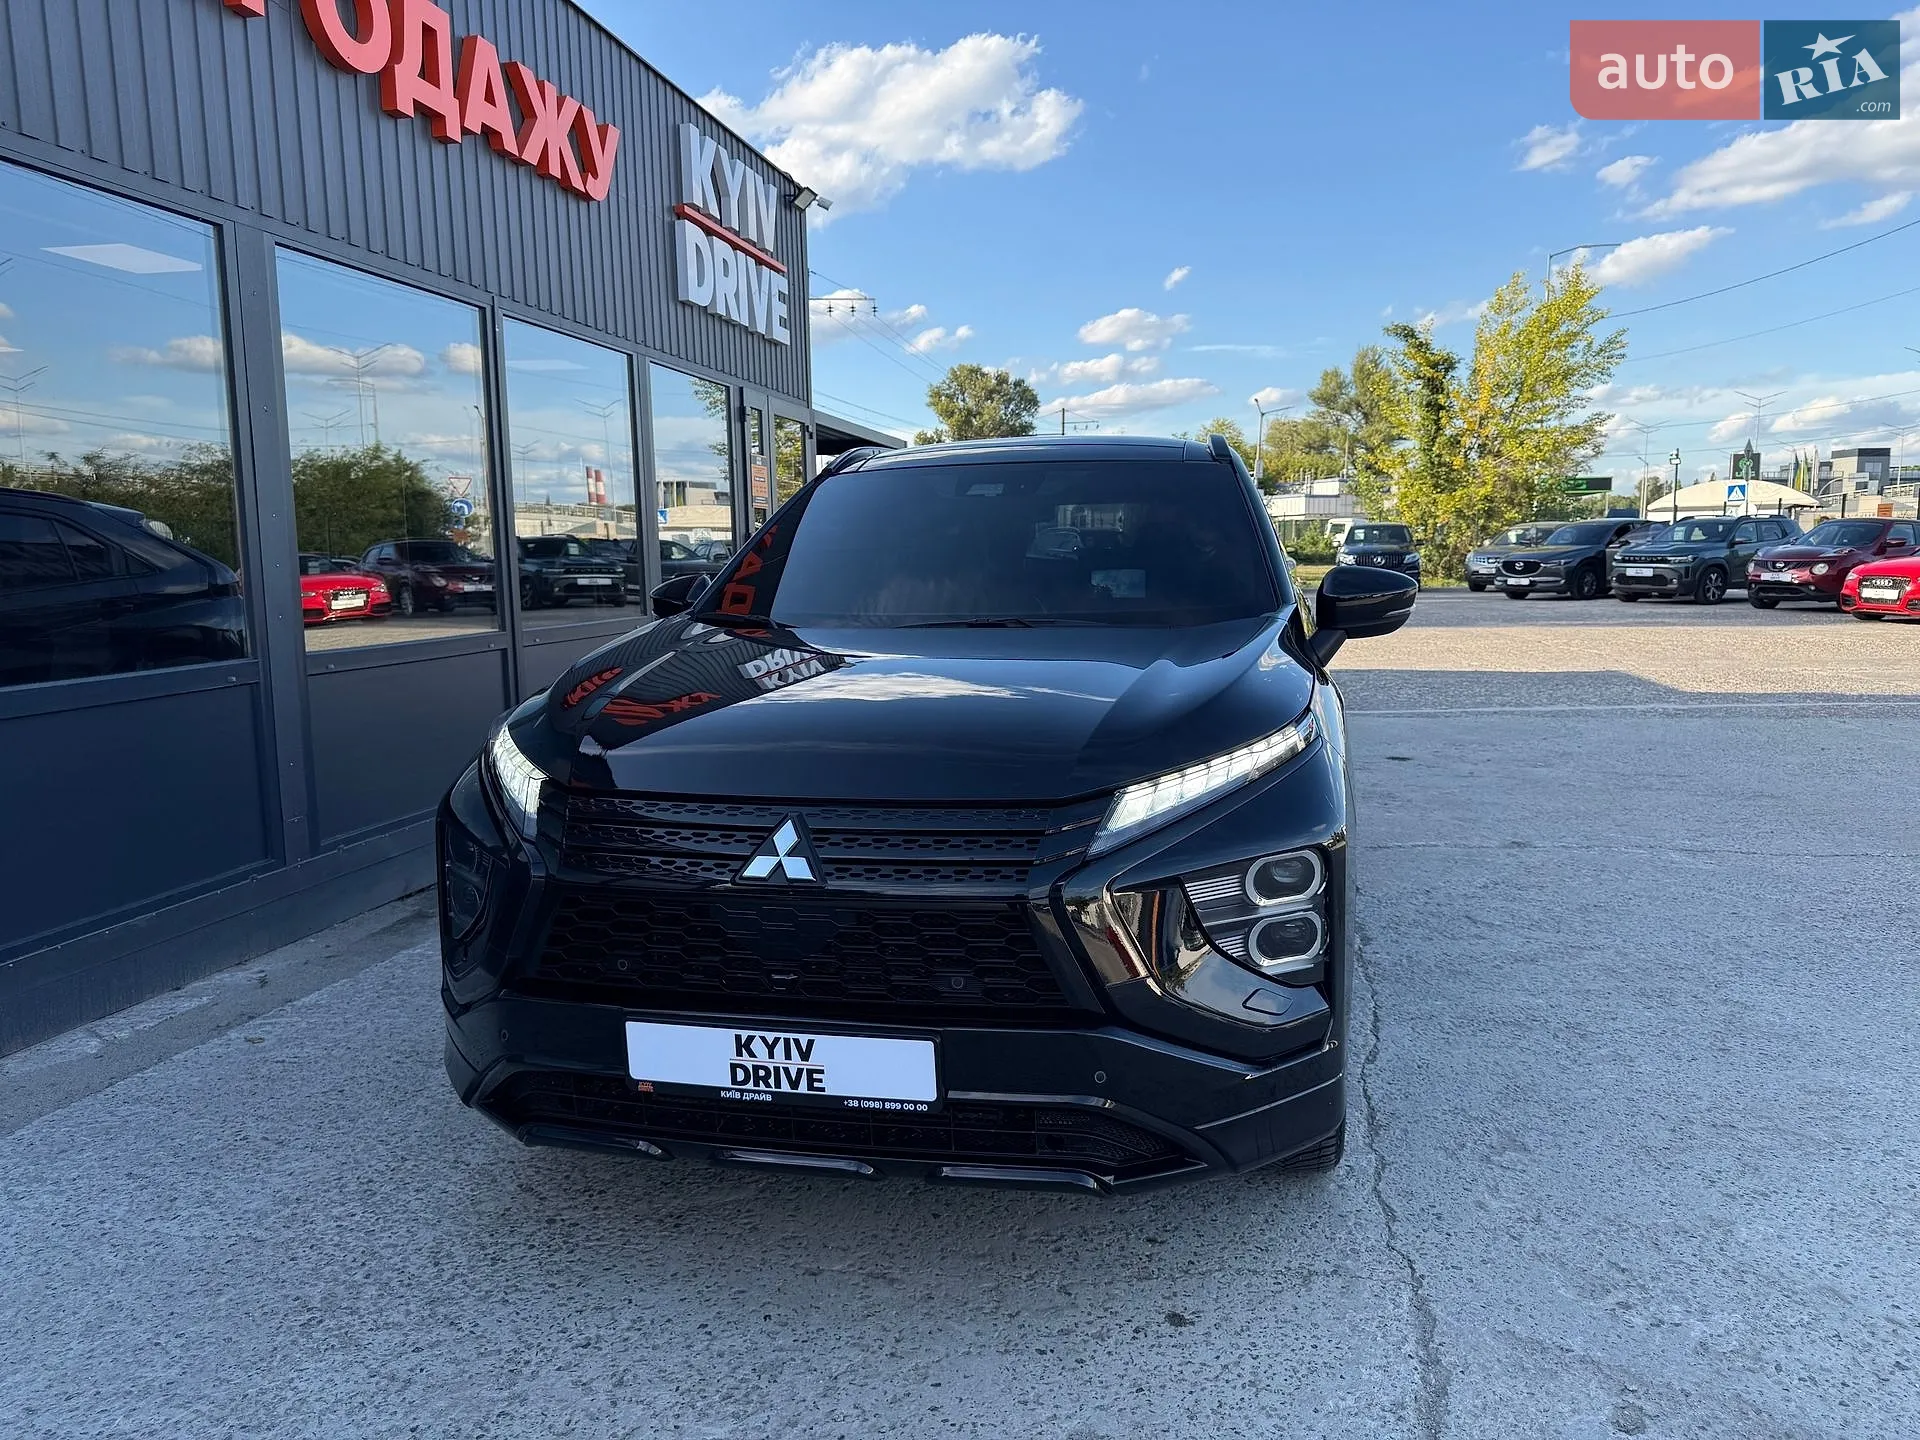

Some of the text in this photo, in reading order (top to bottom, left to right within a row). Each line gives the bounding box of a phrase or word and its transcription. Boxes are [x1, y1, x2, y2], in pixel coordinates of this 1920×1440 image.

[224, 0, 621, 203] ОДАЖУ
[680, 123, 778, 252] KYIV
[675, 218, 790, 345] DRIVE
[735, 1033, 816, 1063] KYIV
[729, 1062, 826, 1093] DRIVE
[720, 1090, 772, 1102] КИЇВ ДРАЙВ
[843, 1099, 859, 1107] +38
[860, 1099, 883, 1110] (098)
[884, 1101, 902, 1110] 899
